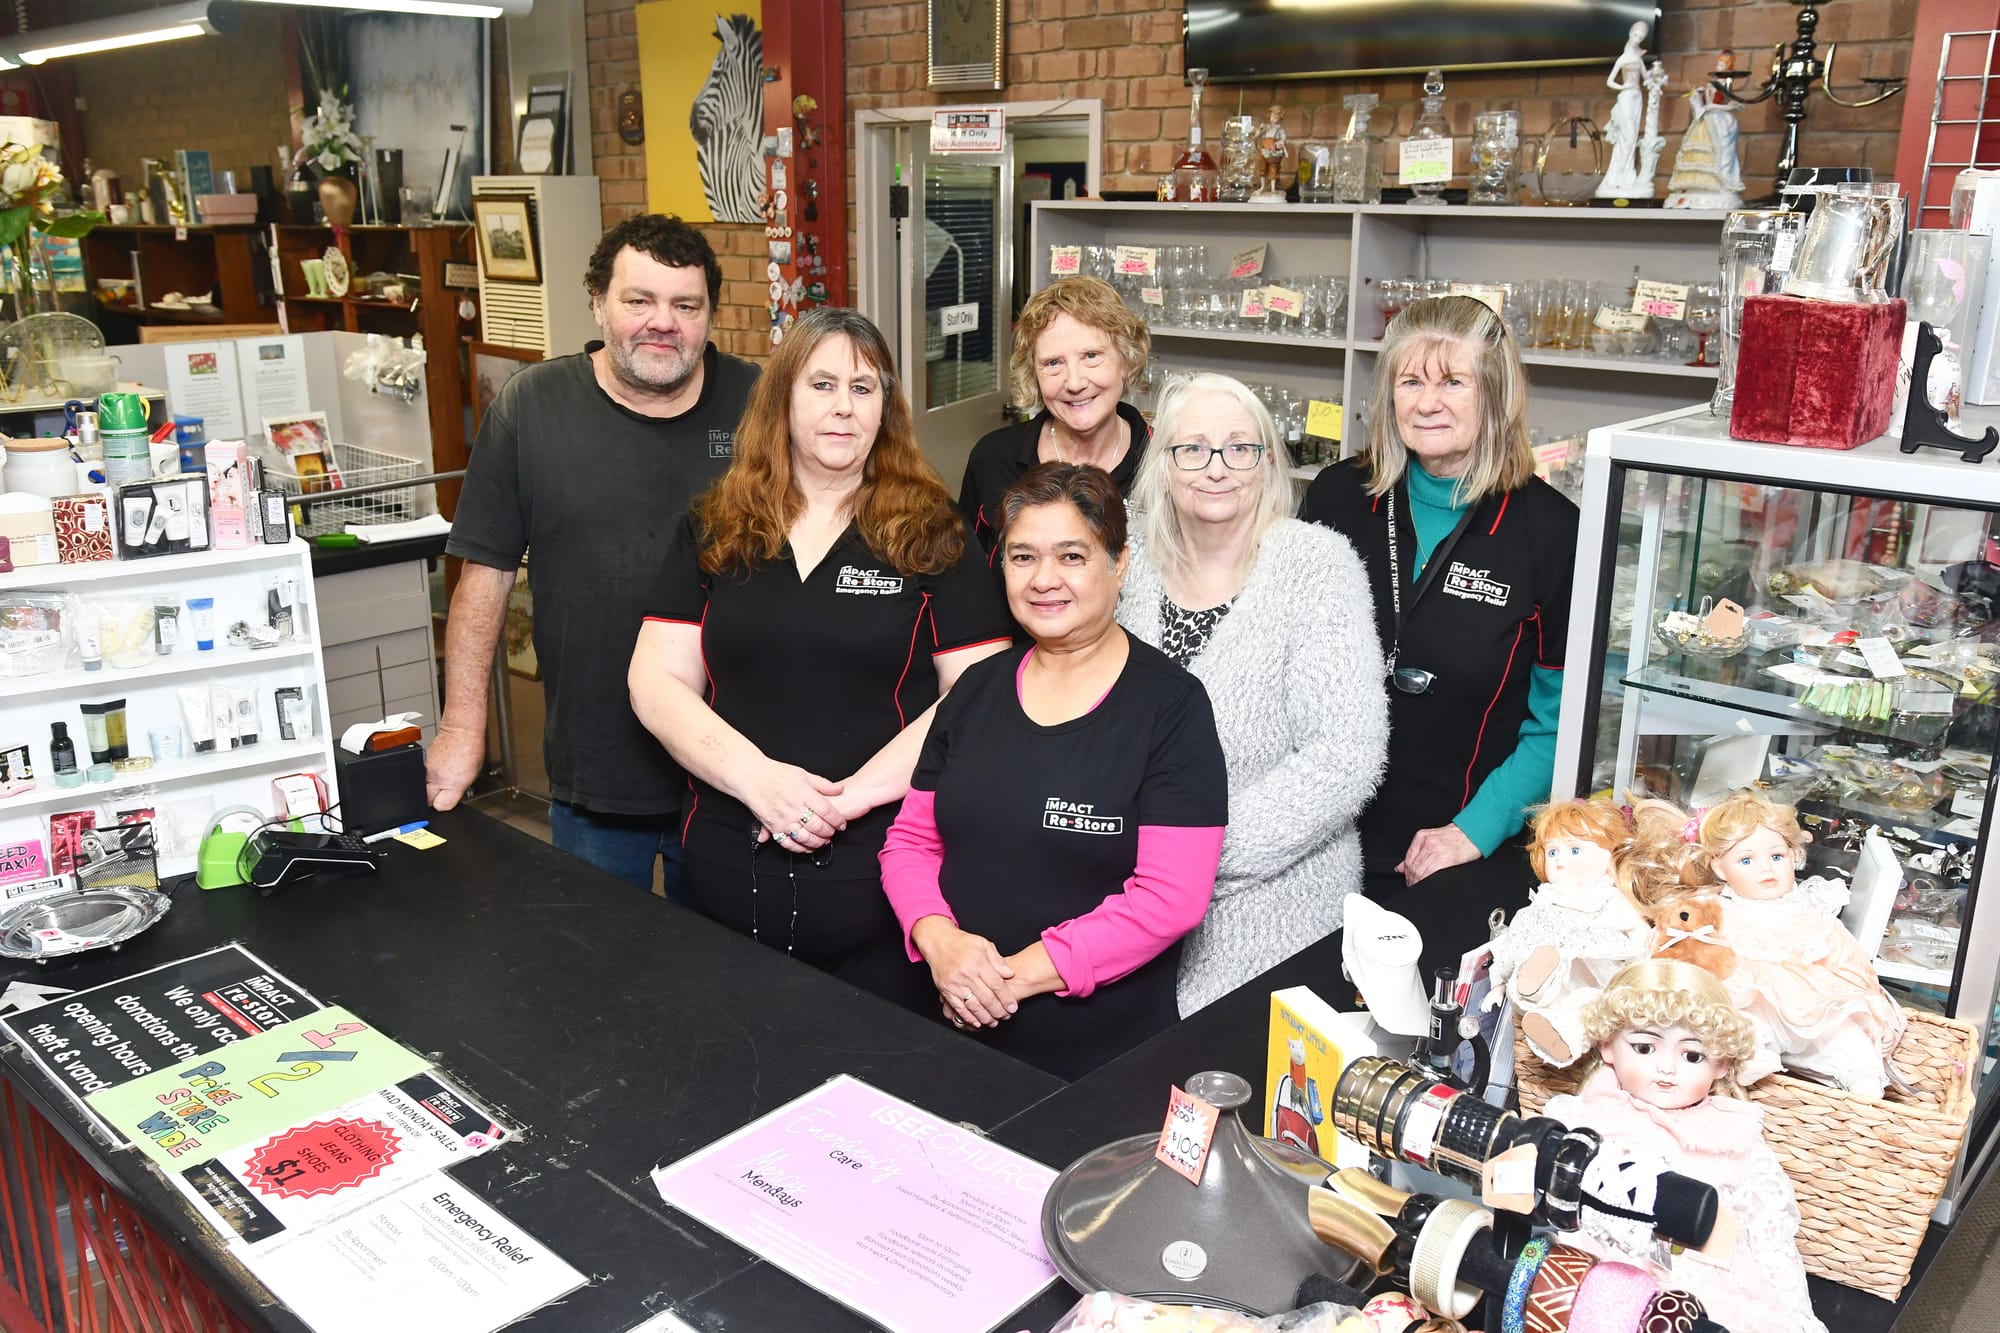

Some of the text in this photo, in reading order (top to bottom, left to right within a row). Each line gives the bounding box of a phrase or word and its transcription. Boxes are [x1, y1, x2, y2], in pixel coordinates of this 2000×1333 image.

[969, 130, 988, 138] Only
[947, 311, 974, 327] Staff Only
[1388, 521, 1396, 538] LIKE
[1389, 546, 1397, 561] DAY
[840, 566, 880, 577] IMPACT
[1391, 561, 1397, 571] AT
[1450, 562, 1491, 579] IMPACT
[836, 587, 878, 596] Emergency
[842, 577, 897, 587] Re-Store
[1451, 575, 1504, 596] Re-Store
[1443, 586, 1508, 607] Emergency Relief
[1045, 797, 1094, 815] IMPACT
[1049, 814, 1116, 831] Re-Store
[244, 975, 295, 1006] IMPACT
[114, 995, 180, 1046] donations
[164, 985, 194, 1006] We
[185, 1006, 221, 1028] only
[211, 1027, 240, 1047] ac
[64, 1002, 152, 1076] opening hours
[1280, 1008, 1327, 1055] STUART LITTLE
[28, 1023, 113, 1093] theft & vand
[156, 1087, 230, 1135] STORE
[378, 1089, 401, 1105] MAD
[395, 1102, 435, 1132] MONDAY
[319, 1142, 352, 1164] JEANS
[333, 1126, 382, 1163] CLOTHING
[297, 1148, 331, 1174] SHOES
[829, 1150, 863, 1170] Care
[262, 1159, 306, 1187] $1
[740, 1170, 803, 1208] Mondays
[433, 1192, 497, 1241] Emergency
[491, 1237, 533, 1265] Relief
[896, 1185, 912, 1197] Food
[981, 1226, 1017, 1250] Community
[1019, 1246, 1050, 1266] Supports
[906, 1256, 941, 1278] Donations
[907, 1267, 956, 1298] complimentary
